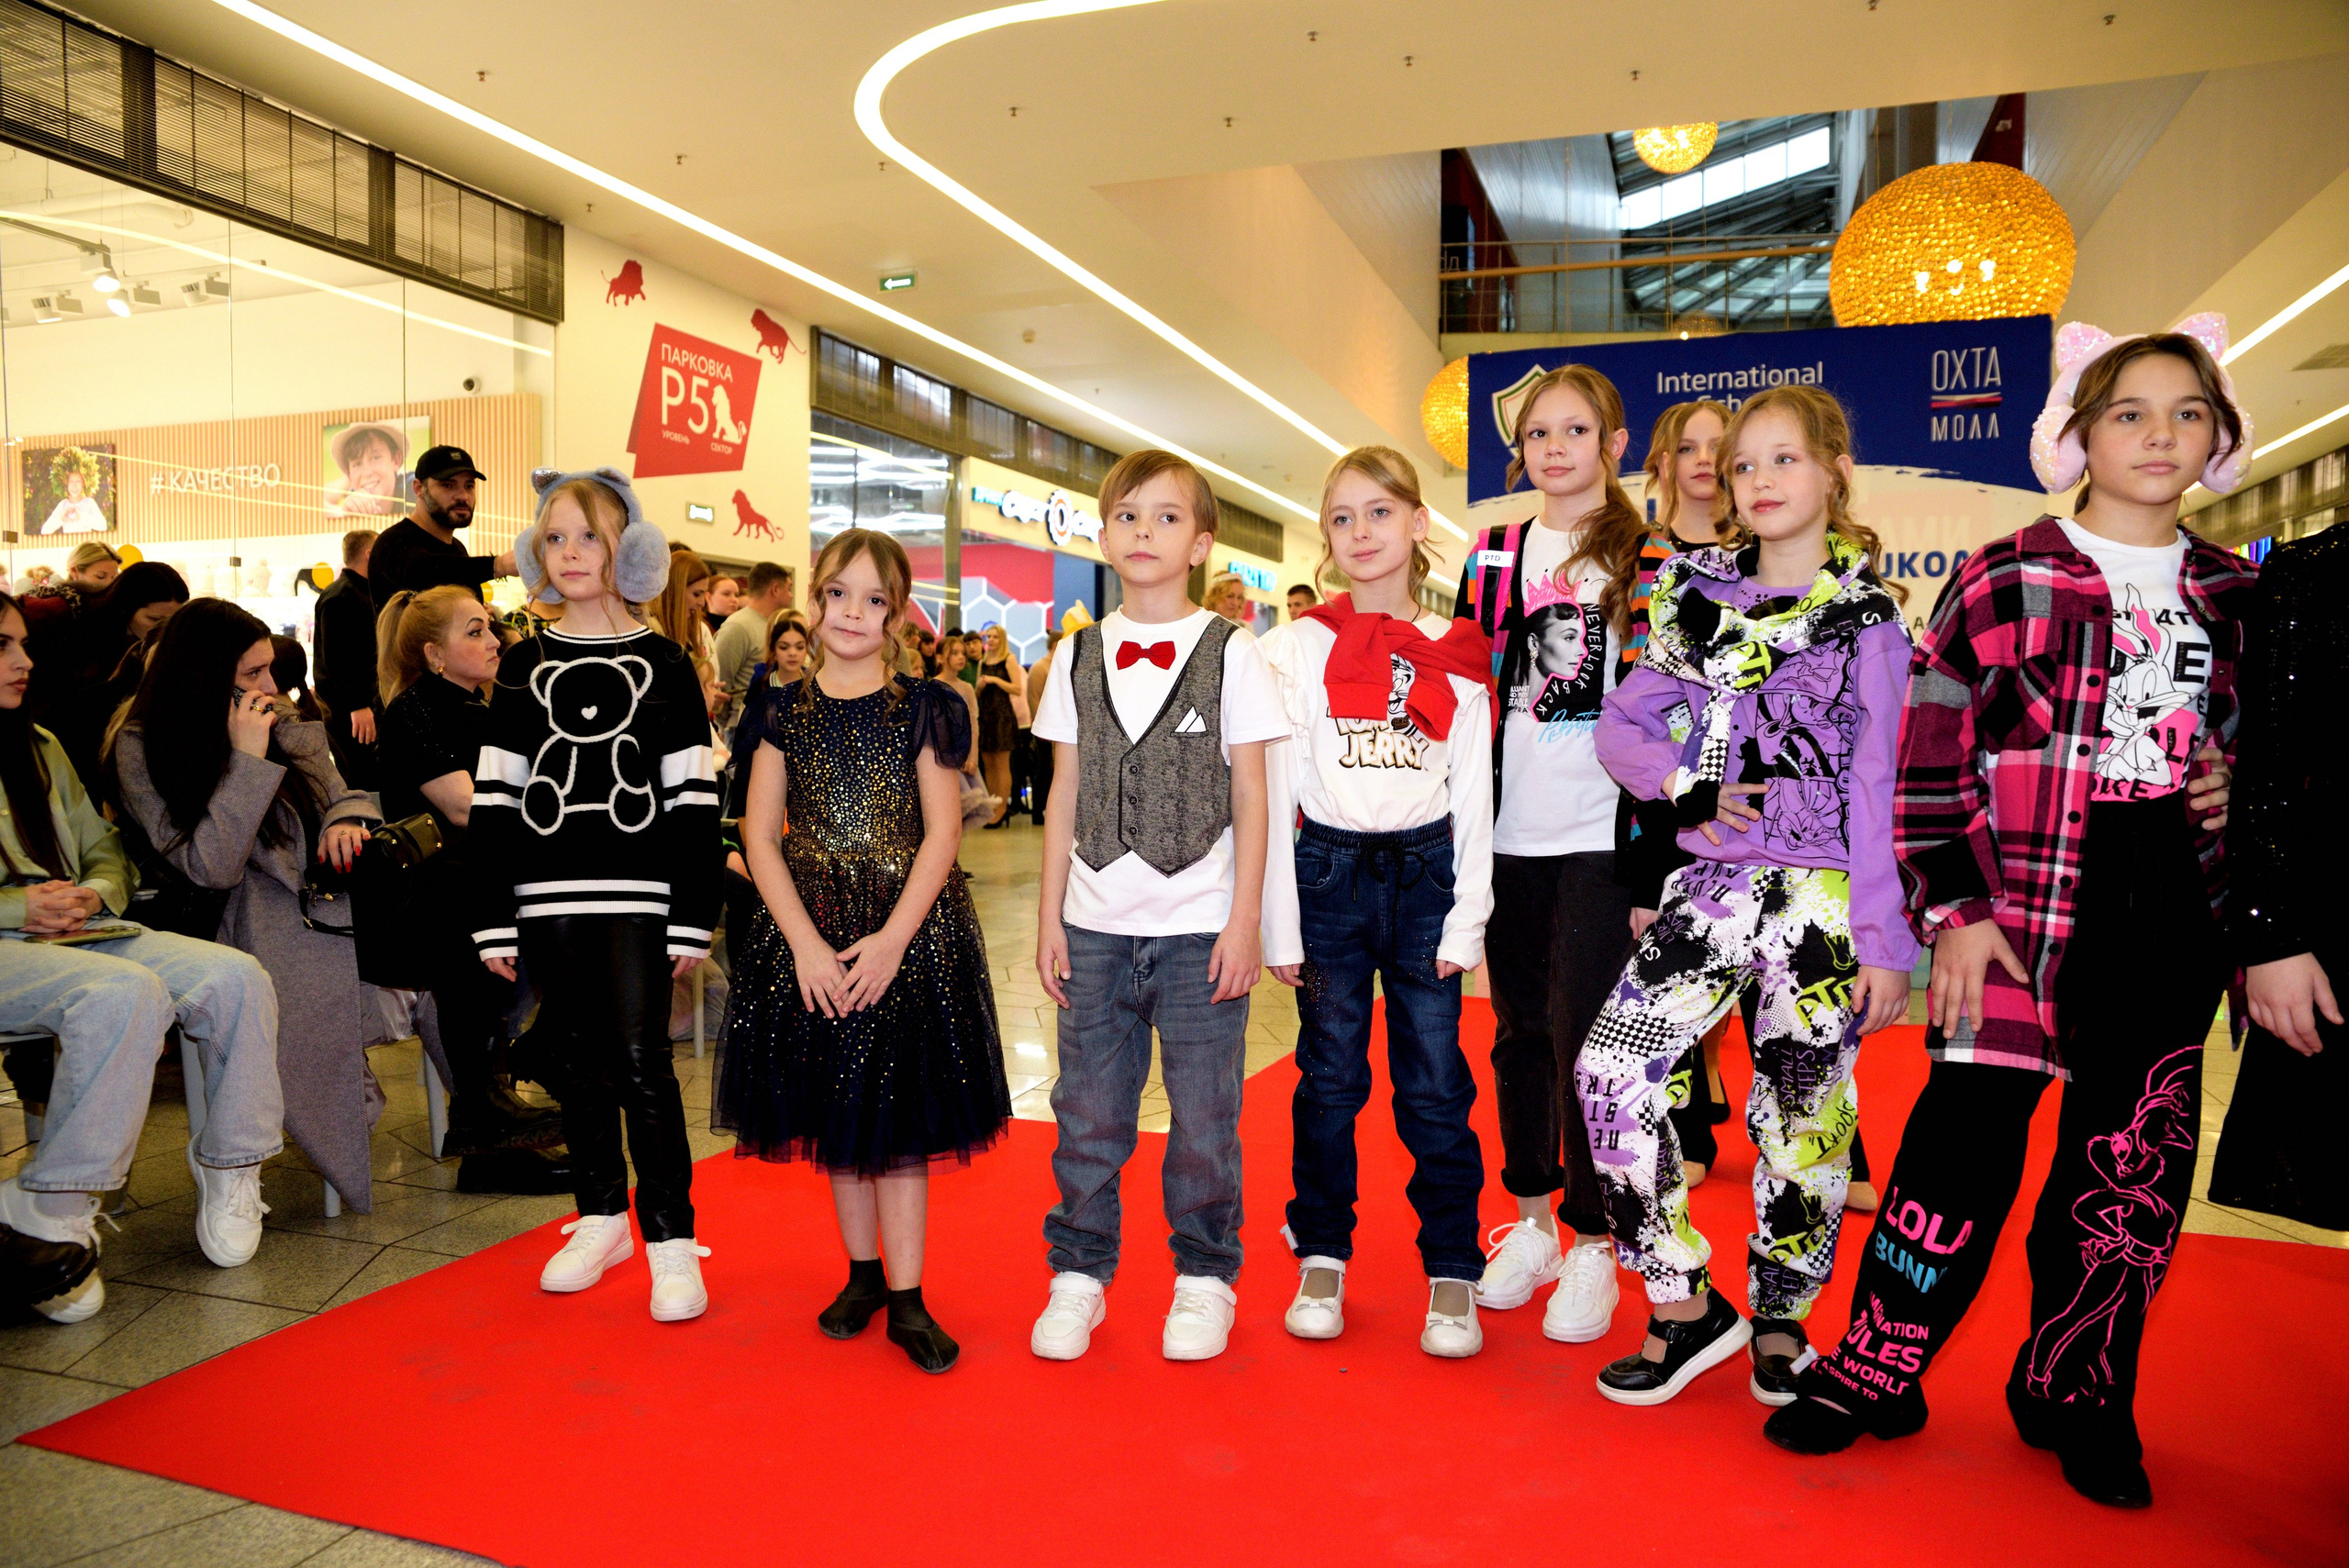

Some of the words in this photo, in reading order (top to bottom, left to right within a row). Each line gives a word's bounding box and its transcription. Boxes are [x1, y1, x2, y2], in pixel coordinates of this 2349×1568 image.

[661, 342, 733, 383] ПАРКОВКА
[1656, 361, 1823, 395] International
[1932, 347, 2001, 392] ОХТА
[662, 428, 690, 444] УРОВЕНЬ
[710, 442, 733, 454] СЕКТОР
[1583, 603, 1603, 651] NEVER
[1575, 654, 1600, 690] LOOK
[1536, 680, 1570, 716] BACK
[1339, 732, 1430, 770] JERRY
[1821, 1361, 1860, 1392] ASPIRE
[1862, 1387, 1878, 1401] TO
